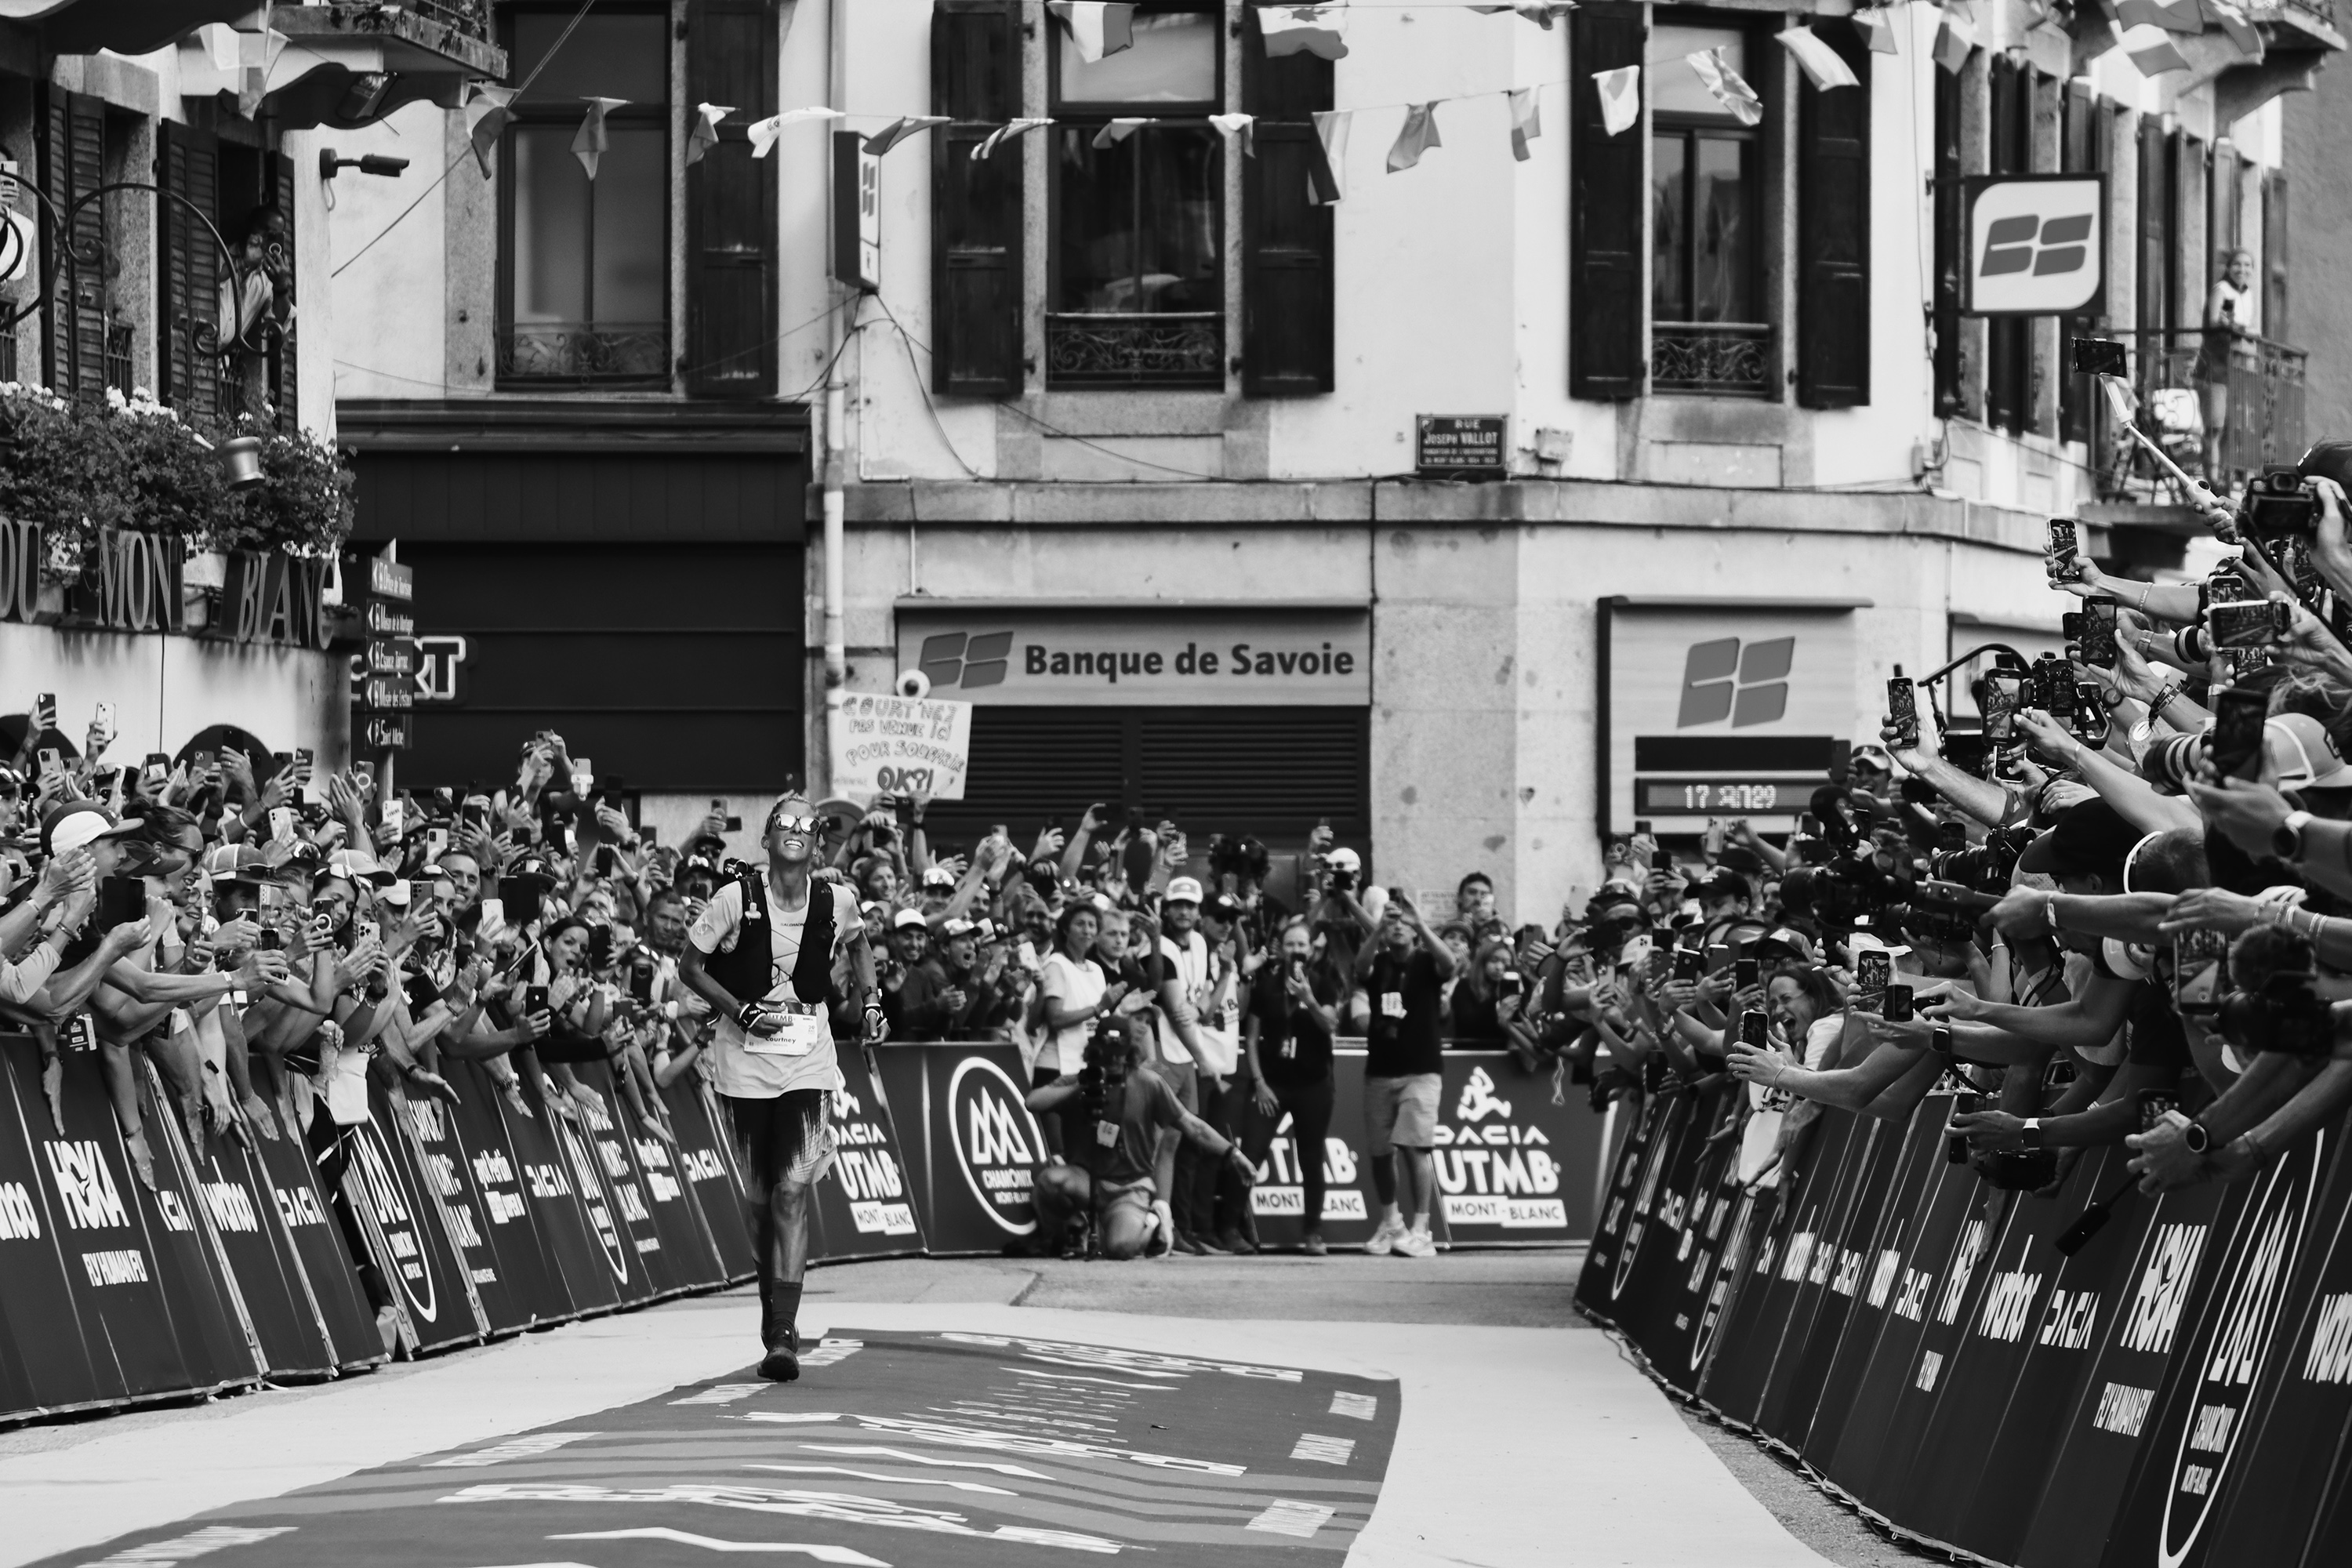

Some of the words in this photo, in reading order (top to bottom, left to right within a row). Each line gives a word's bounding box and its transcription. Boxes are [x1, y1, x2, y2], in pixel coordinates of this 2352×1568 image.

[1454, 419, 1481, 430] RUE
[1460, 432, 1497, 445] VALLOT
[238, 550, 336, 650] BLANC
[380, 641, 394, 671] Espace
[1025, 644, 1164, 684] Banque
[1175, 642, 1219, 675] de
[1231, 642, 1355, 675] Savoie
[380, 719, 391, 745] Saint
[849, 719, 875, 734] PAS
[879, 719, 925, 738] VENUE
[845, 740, 891, 767] POUR
[877, 765, 935, 793] OK?!
[829, 1123, 887, 1145] DACIA
[1432, 1124, 1550, 1145] DACIA
[43, 1140, 131, 1230] HOKA
[473, 1151, 495, 1191] ayot
[524, 1163, 572, 1198] DACIA
[681, 1149, 726, 1183] DACIA
[835, 1147, 903, 1200] UTMB
[1432, 1147, 1561, 1195] UTMB
[201, 1156, 260, 1233] wahoo
[275, 1186, 326, 1228] DACIA
[82, 1253, 103, 1287] FLY
[99, 1250, 135, 1285] HUMAN
[127, 1249, 149, 1282] FLY
[1832, 1248, 1864, 1298] DACIA
[2120, 1223, 2208, 1354] HOKA
[1894, 1267, 1933, 1323] DACI
[2040, 1289, 2102, 1350] DACIA
[2093, 1381, 2120, 1428] FLY
[2104, 1384, 2145, 1436] HUMAN
[2128, 1388, 2155, 1438] FLY
[2190, 1403, 2237, 1454] CHAMONIX
